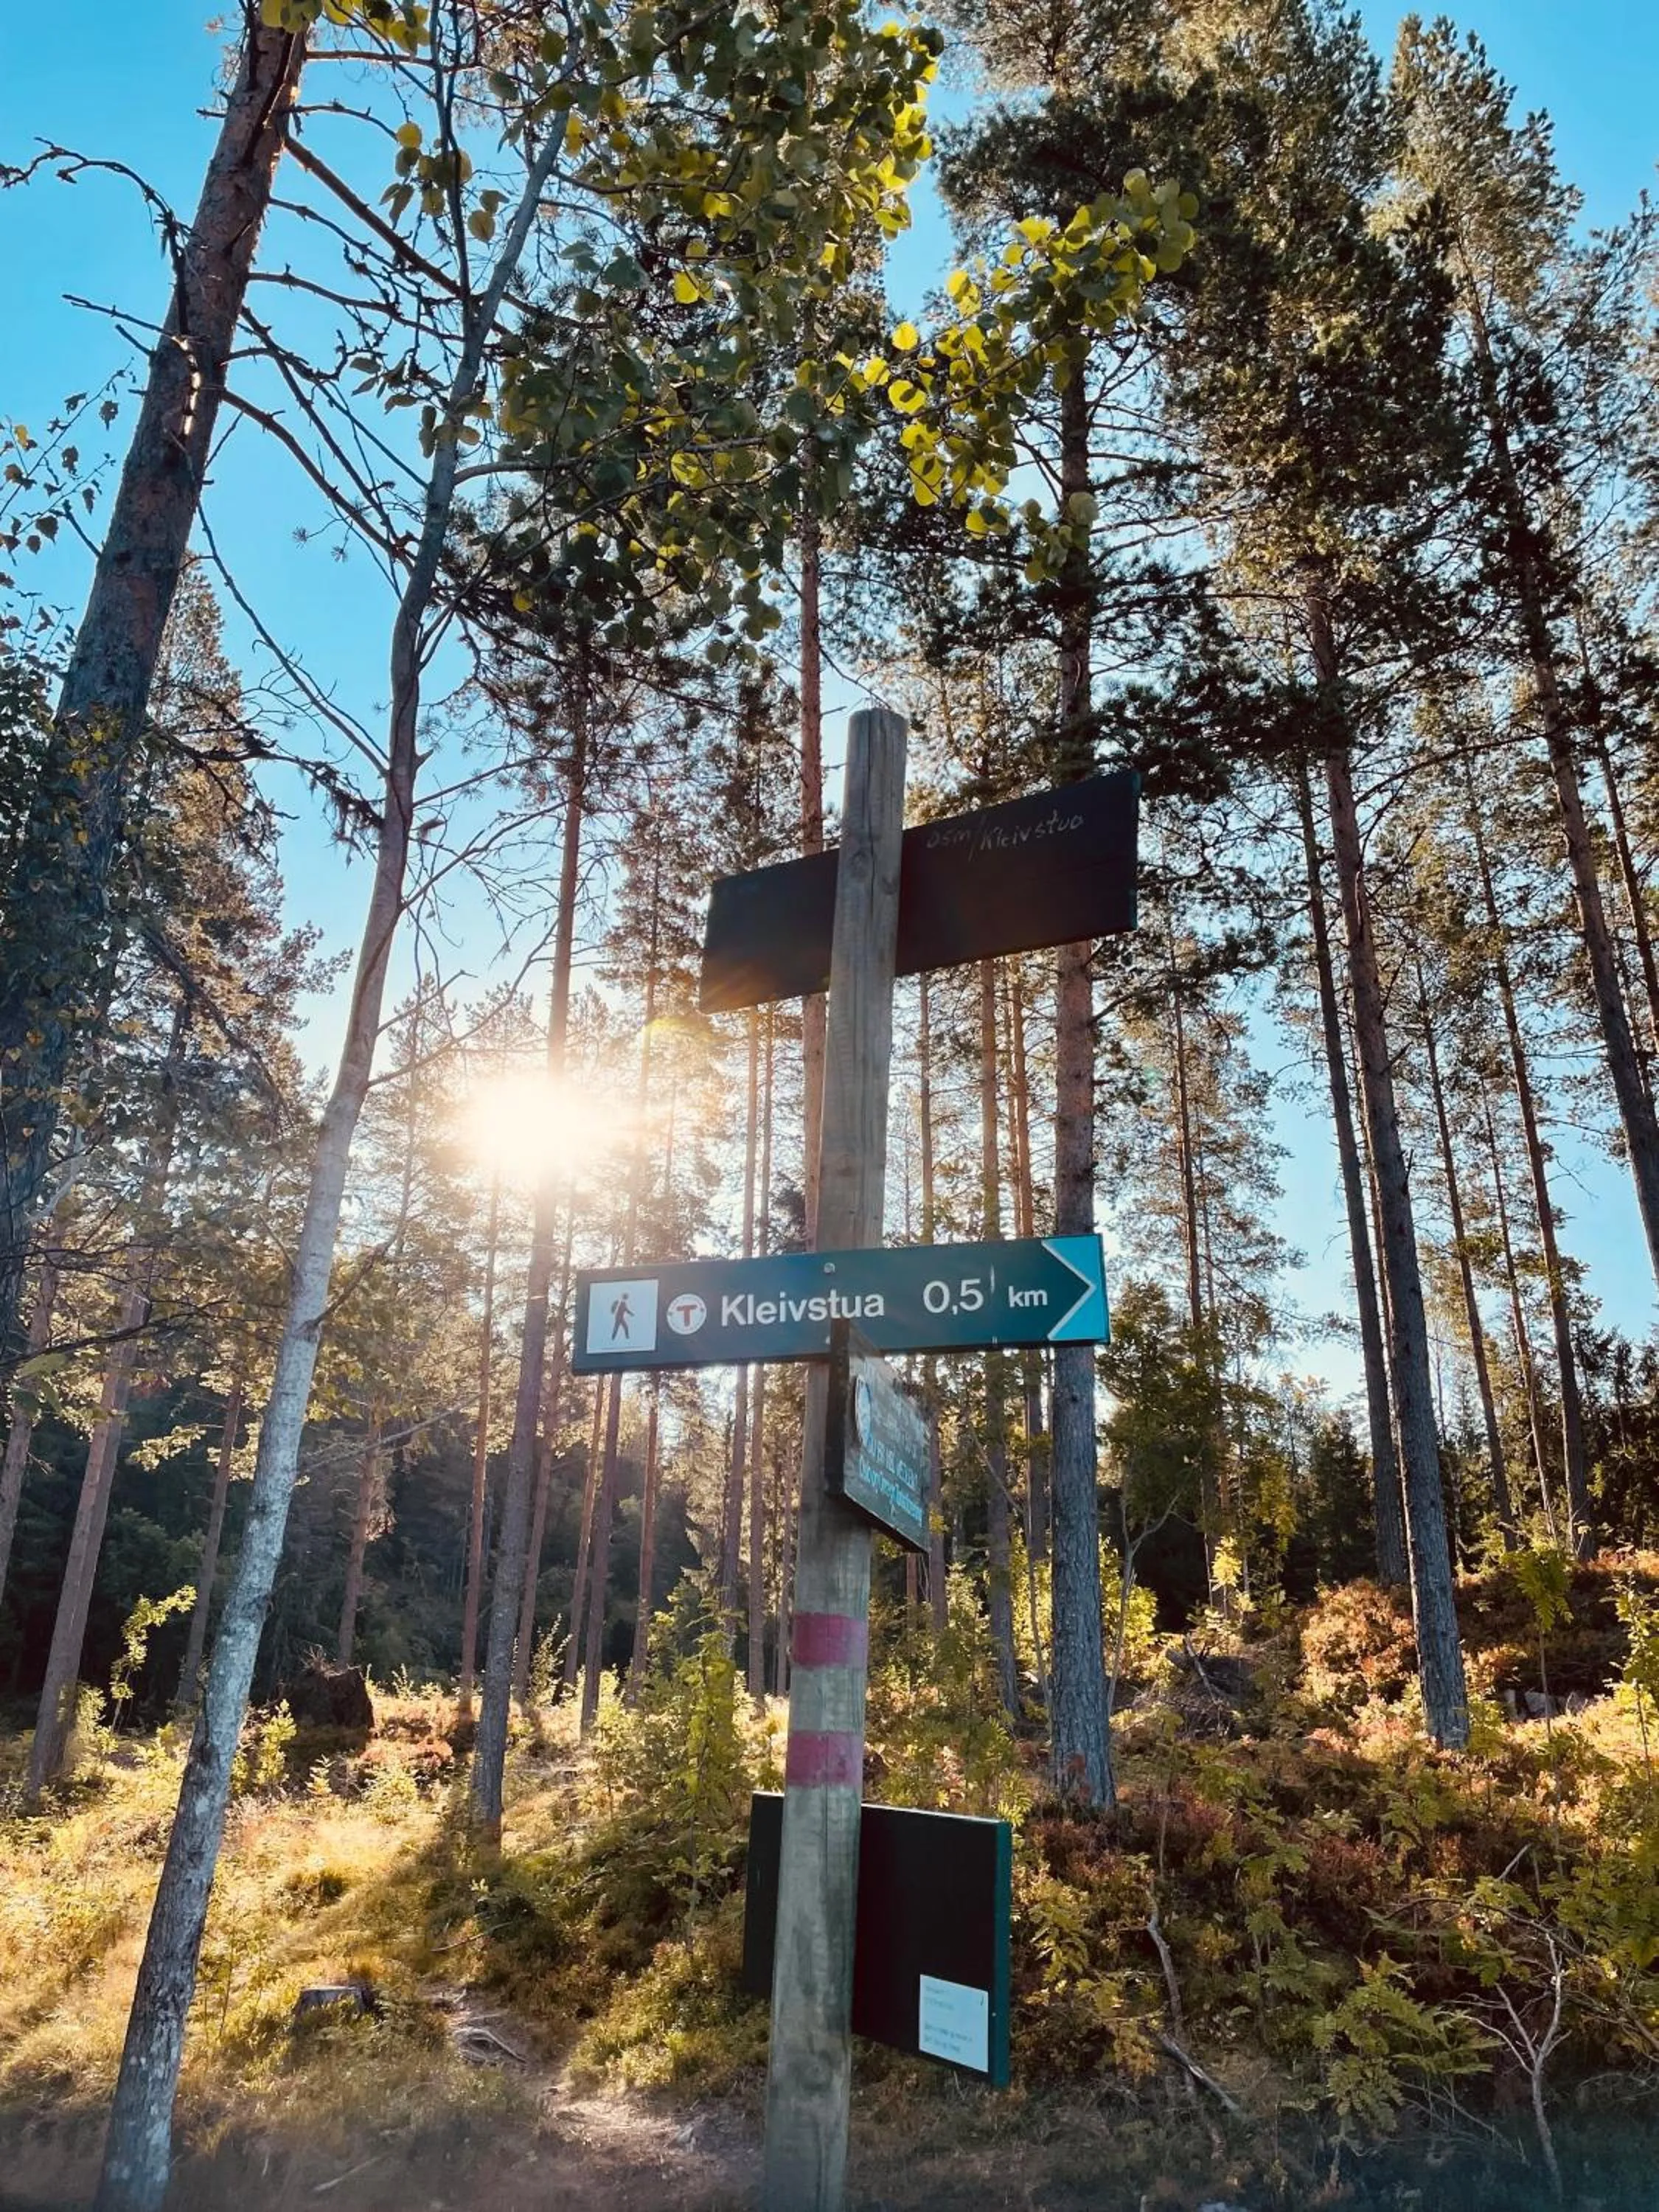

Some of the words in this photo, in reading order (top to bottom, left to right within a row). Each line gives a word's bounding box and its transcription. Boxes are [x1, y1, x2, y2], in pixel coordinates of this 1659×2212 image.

[675, 1304, 698, 1327] T
[721, 1289, 885, 1326] Kleivstua
[923, 1278, 984, 1315] 0,5
[1008, 1285, 1048, 1307] km
